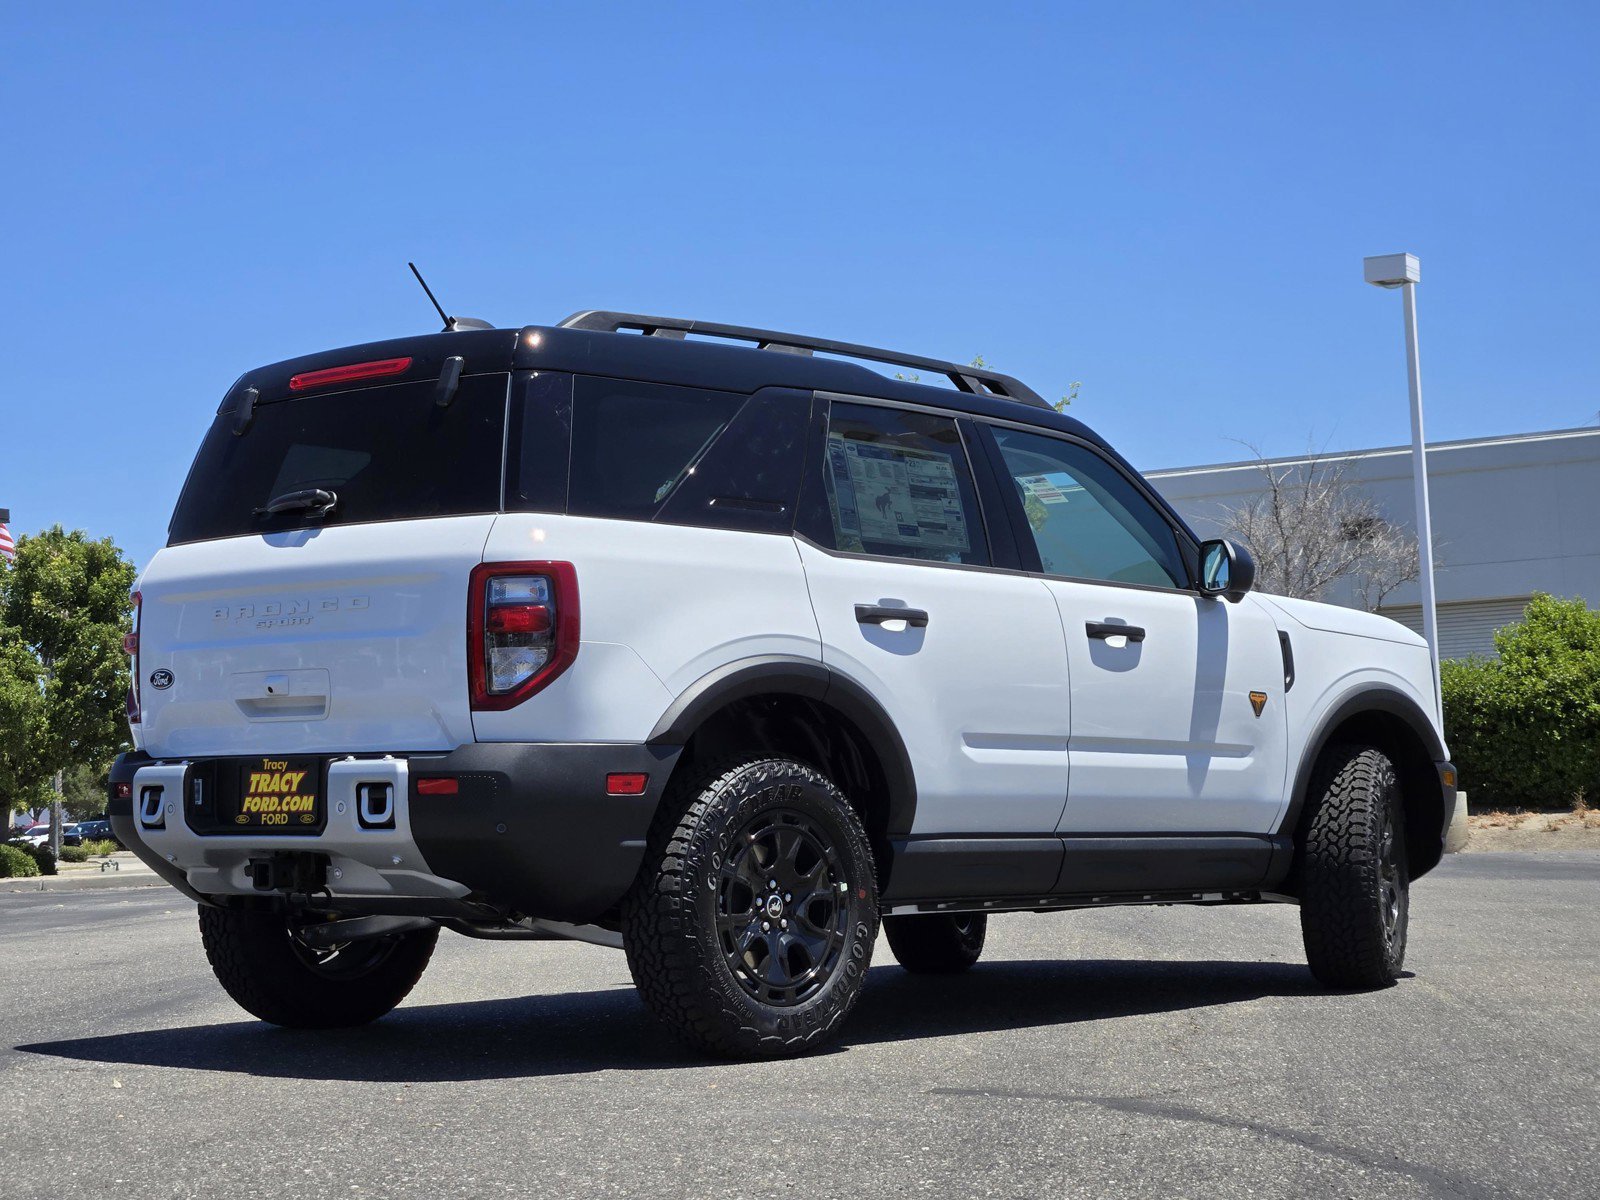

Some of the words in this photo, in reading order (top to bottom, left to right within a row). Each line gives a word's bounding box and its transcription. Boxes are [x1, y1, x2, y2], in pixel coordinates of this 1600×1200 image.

[212, 596, 370, 620] BRONCO
[256, 616, 314, 629] SPORT
[262, 758, 288, 772] Tracy
[250, 772, 306, 793] TRACY
[242, 795, 315, 812] FORD.COM
[261, 813, 289, 825] FORD
